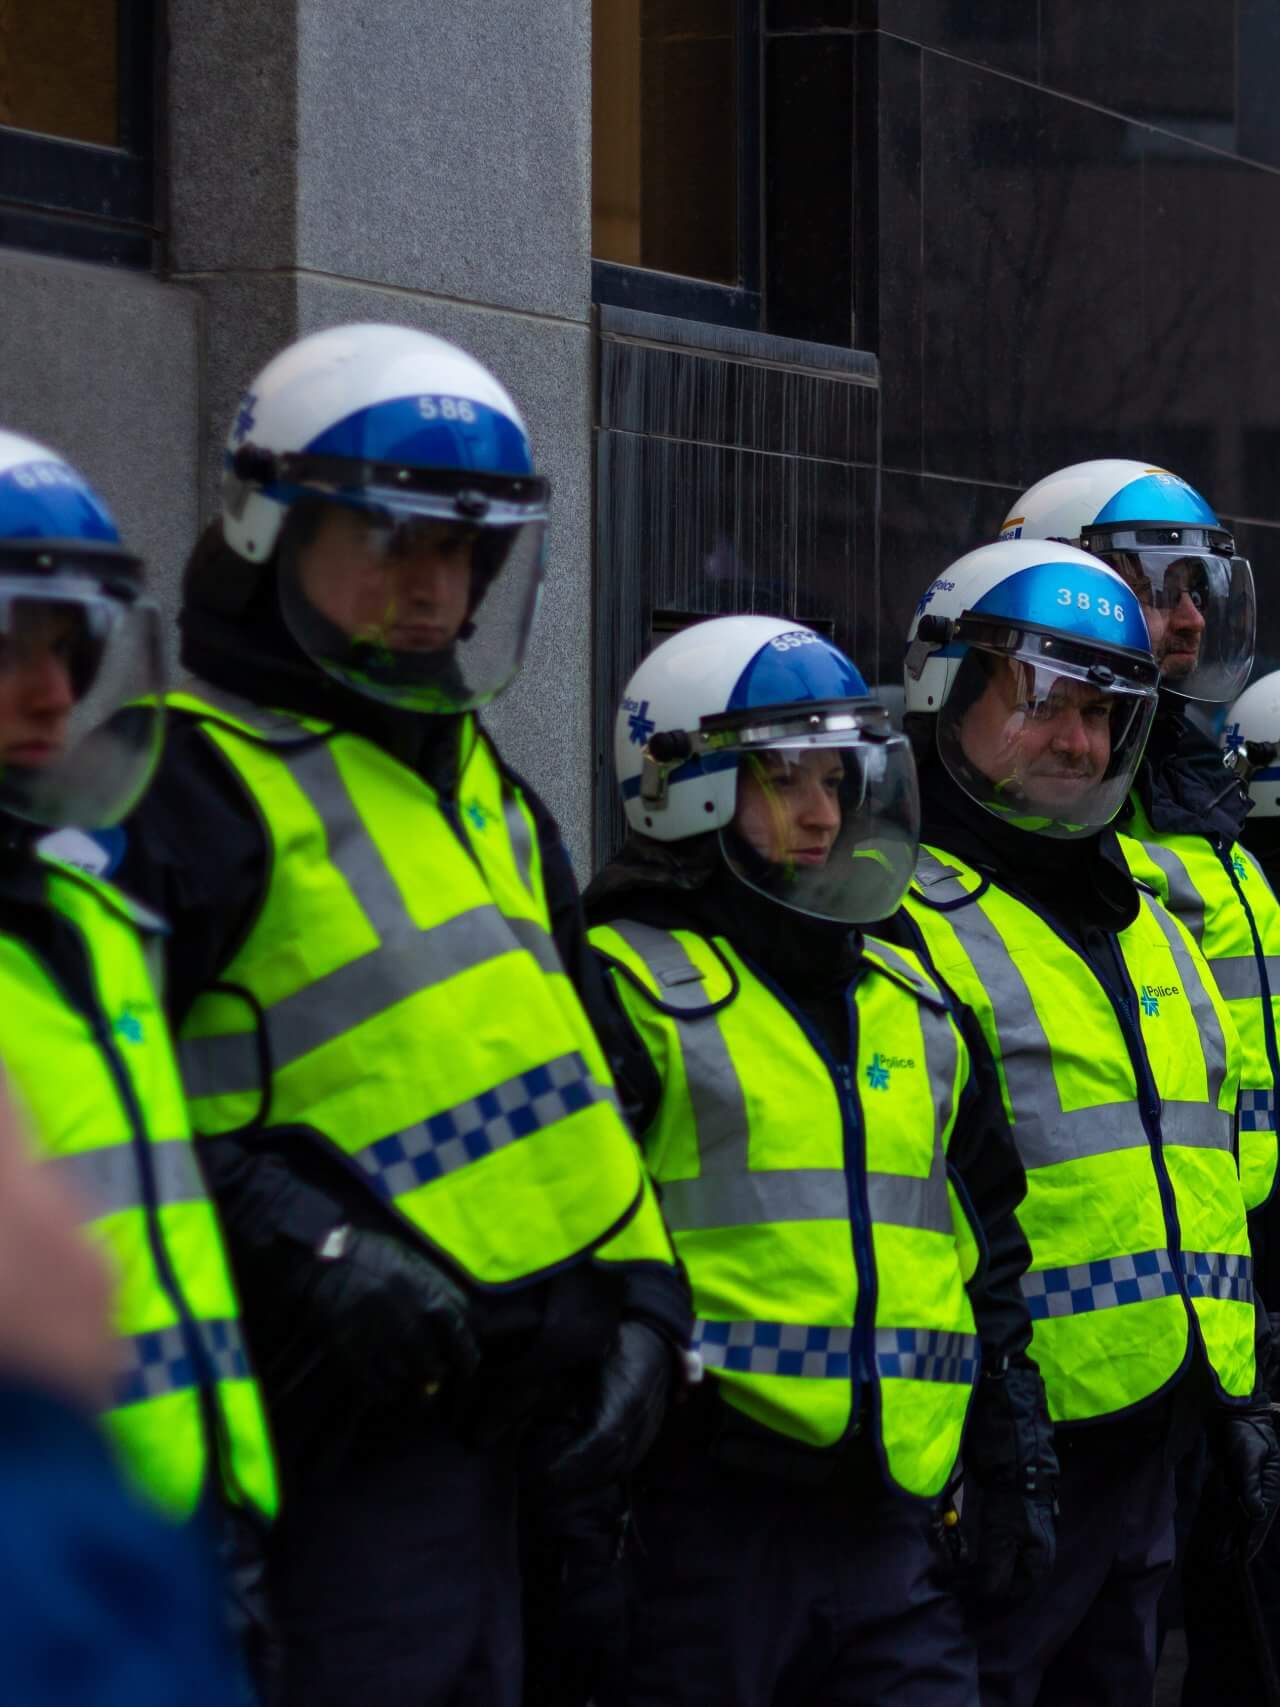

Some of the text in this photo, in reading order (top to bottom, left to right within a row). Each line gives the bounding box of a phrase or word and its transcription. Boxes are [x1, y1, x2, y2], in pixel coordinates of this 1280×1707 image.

[418, 395, 477, 423] 586
[1056, 588, 1125, 623] 3836
[1146, 985, 1180, 998] Police
[879, 1053, 916, 1070] Police
